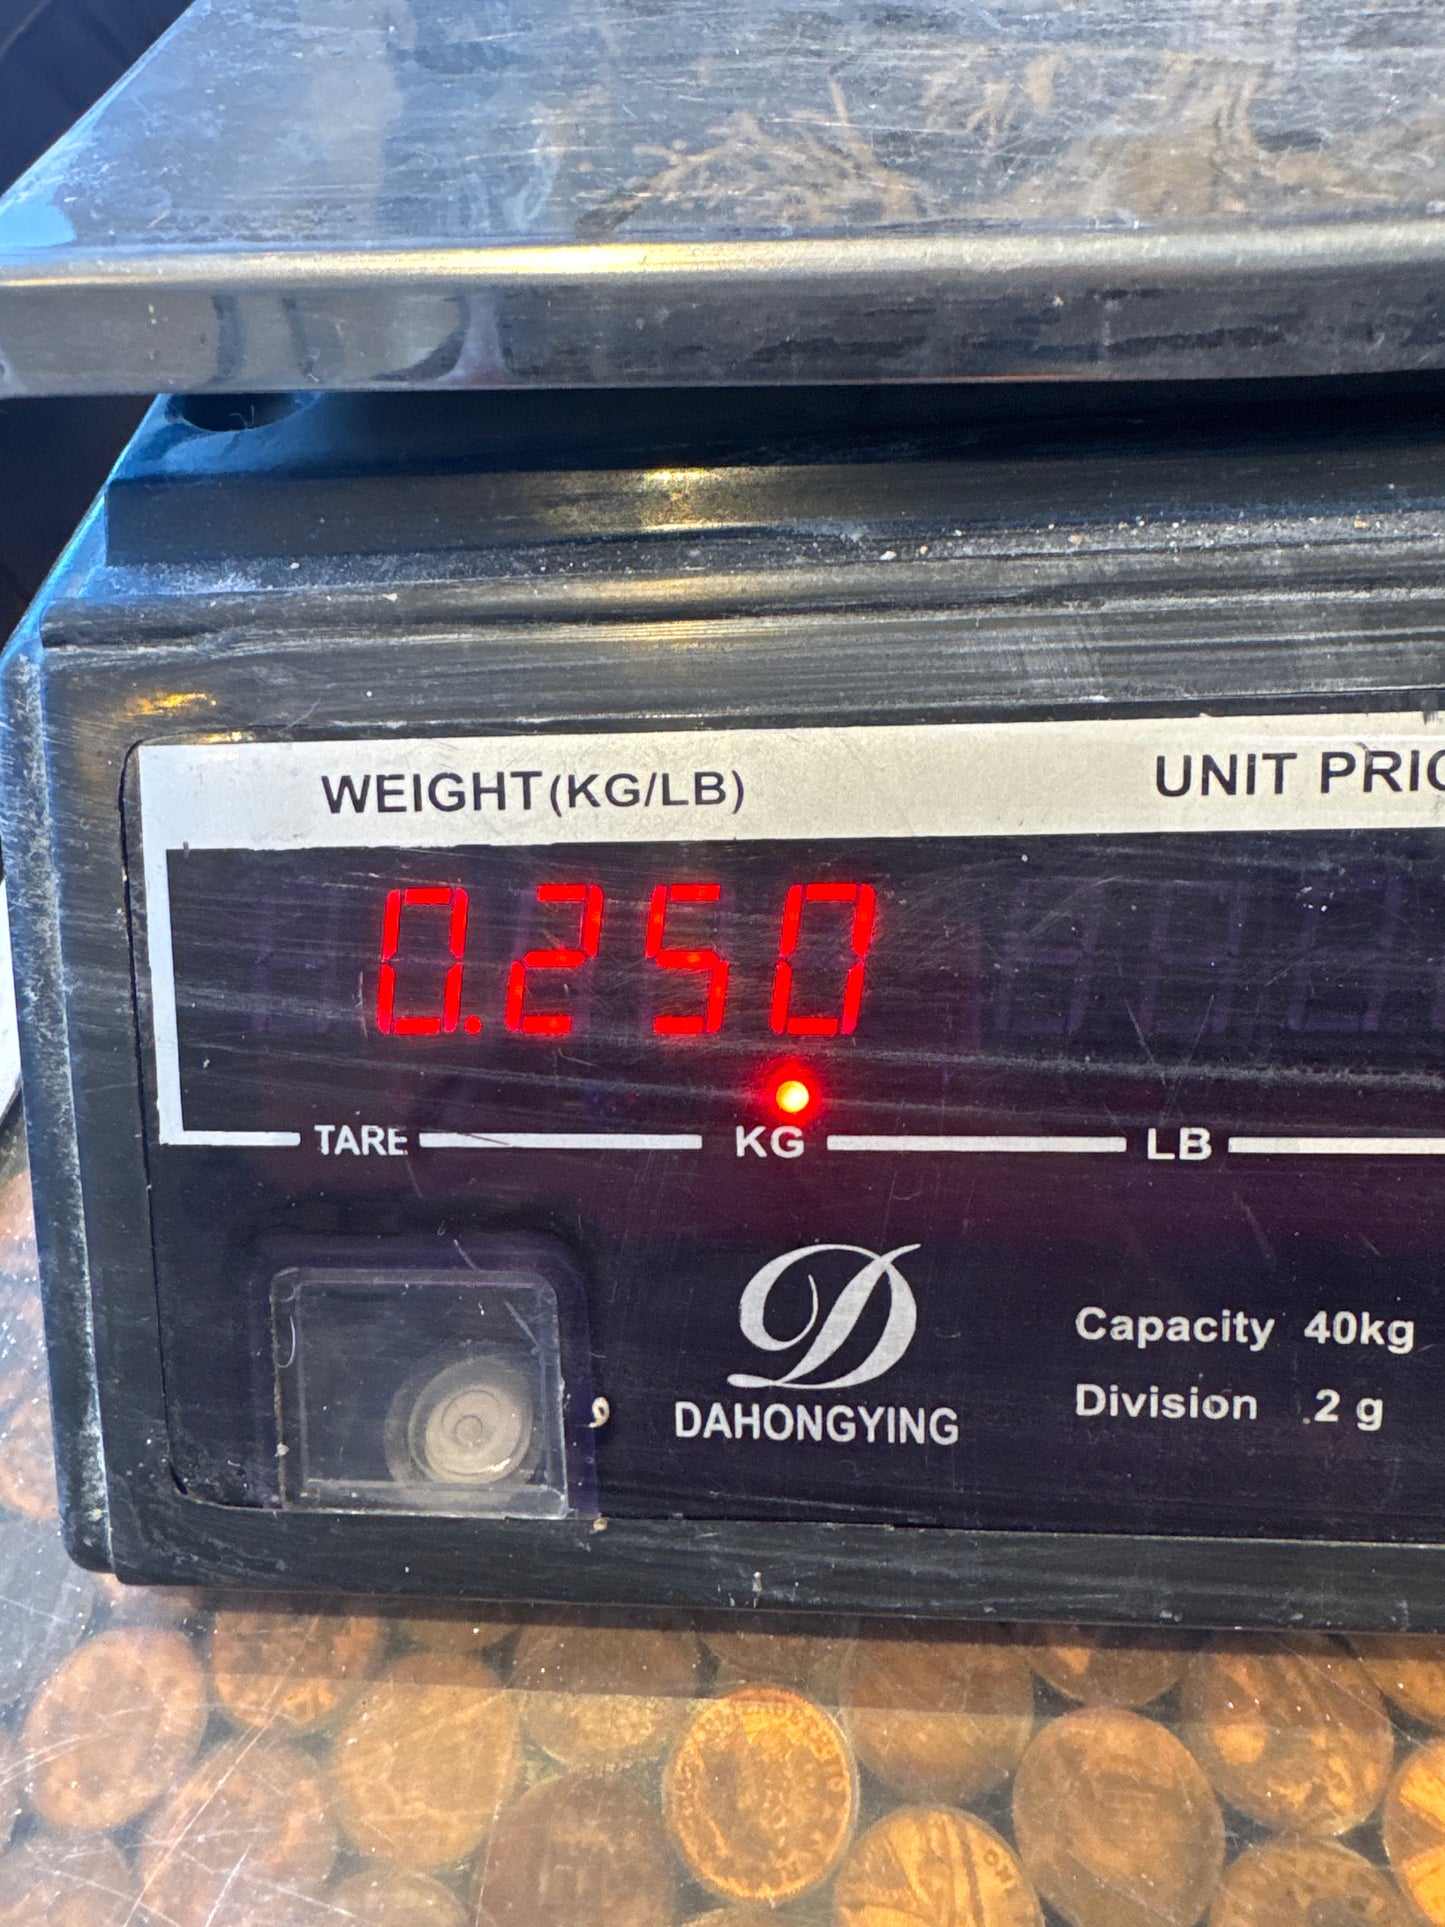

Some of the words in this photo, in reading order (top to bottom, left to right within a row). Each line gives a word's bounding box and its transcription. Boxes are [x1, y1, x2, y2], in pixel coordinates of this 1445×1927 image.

[322, 771, 743, 816] WEIGHT(KG/LB)
[1157, 752, 1297, 797] UNIT
[377, 882, 876, 1036] 0.250
[314, 1125, 408, 1156] TARE
[735, 1126, 805, 1159] KG
[1147, 1128, 1212, 1161] LB
[1075, 1306, 1275, 1351] Capacity
[1304, 1310, 1415, 1354] 40kg
[675, 1402, 959, 1446] DAHONGYING
[1075, 1383, 1258, 1420] Division
[1356, 1398, 1384, 1431] g
